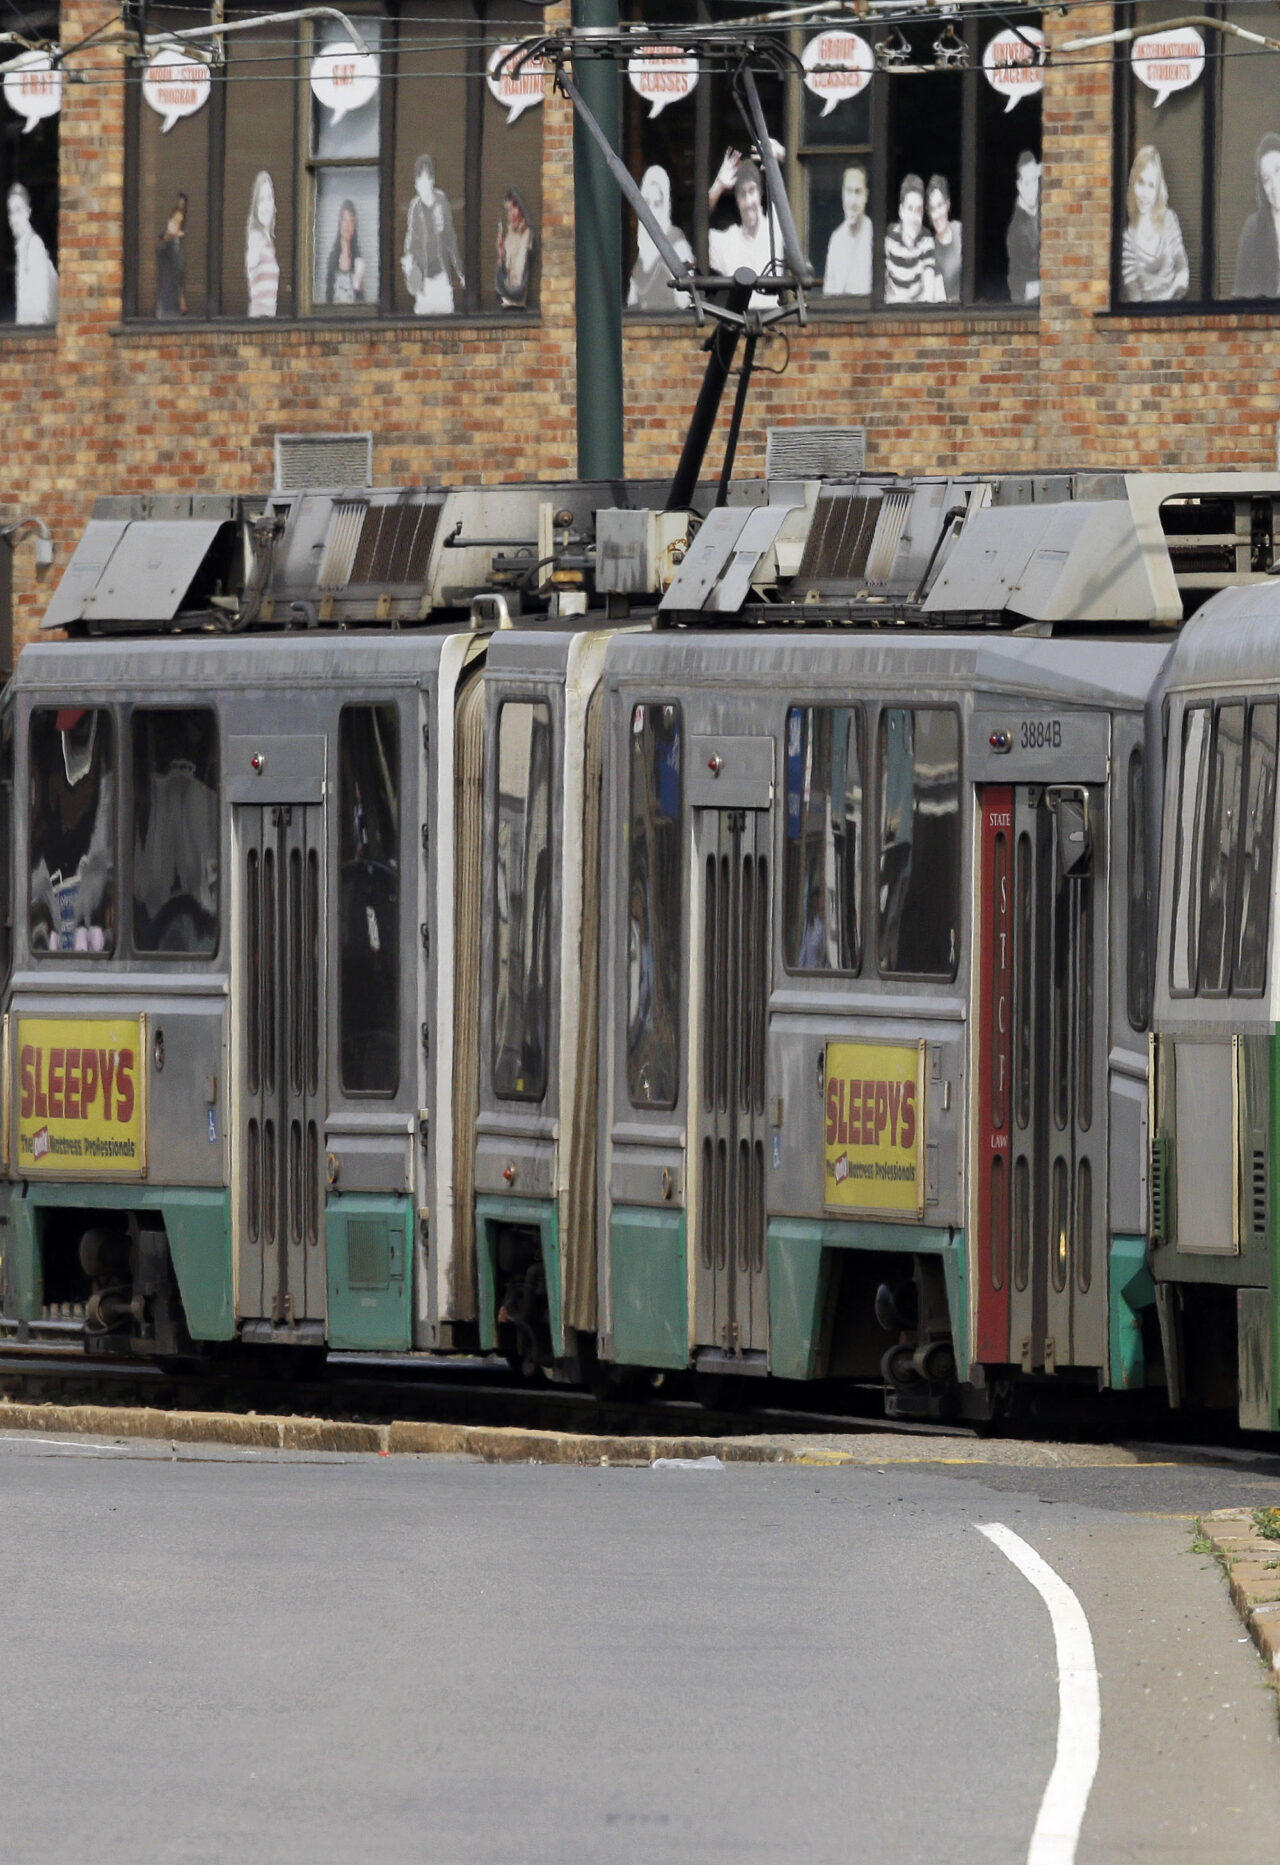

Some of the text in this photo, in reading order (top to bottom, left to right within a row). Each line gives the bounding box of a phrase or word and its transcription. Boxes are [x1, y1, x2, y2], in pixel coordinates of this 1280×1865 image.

[640, 70, 689, 92] CLASSES
[1020, 720, 1062, 749] 3884B
[989, 813, 1011, 827] STATE
[84, 1136, 135, 1158] Professionals
[990, 1134, 1008, 1149] LAW
[875, 1161, 915, 1182] Professionals
